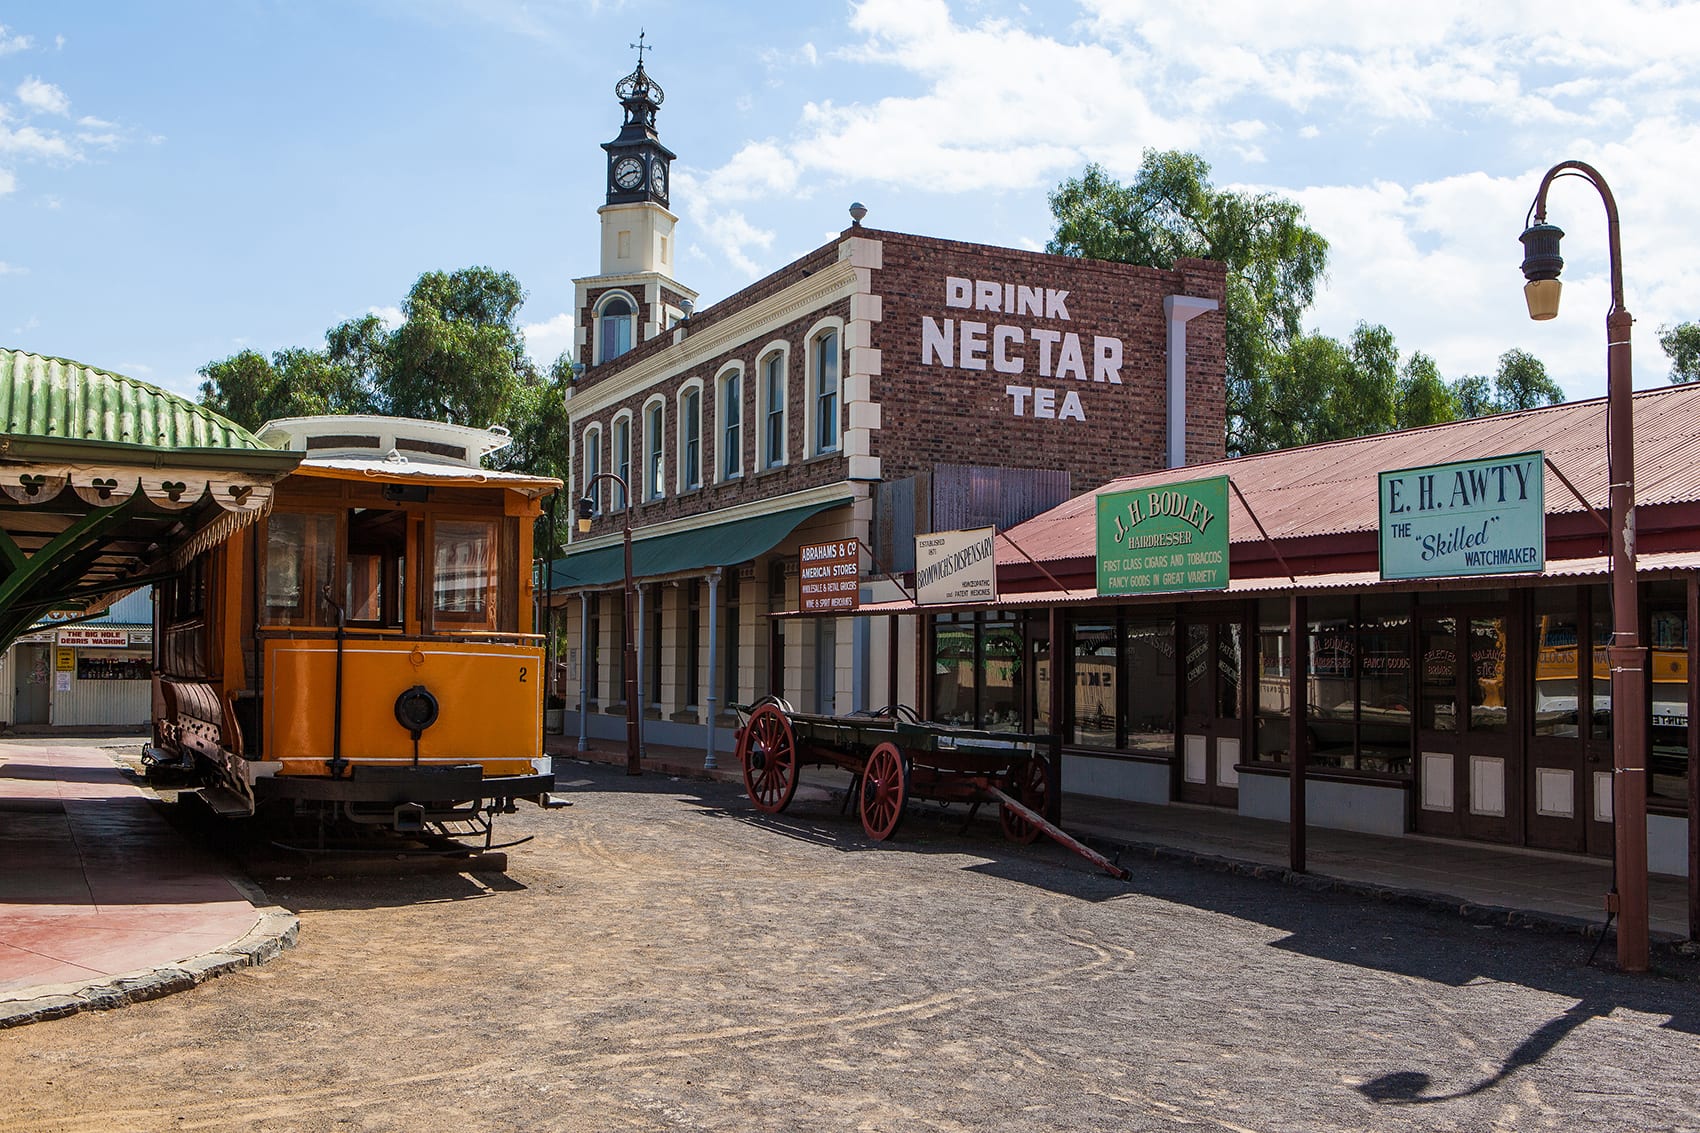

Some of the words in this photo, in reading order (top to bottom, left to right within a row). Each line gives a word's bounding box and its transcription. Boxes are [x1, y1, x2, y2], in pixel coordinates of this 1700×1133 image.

[946, 276, 1071, 321] DRINK
[922, 316, 1123, 384] NECTAR
[1006, 385, 1087, 422] TEA
[1389, 479, 1411, 514] E.
[1419, 475, 1443, 510] H.
[1449, 462, 1532, 508] AWTY
[1114, 515, 1129, 543] J.
[1128, 500, 1146, 527] H.
[1148, 491, 1214, 535] BODLEY
[1391, 523, 1412, 538] THE
[919, 538, 945, 548] ESTABLISHED
[1128, 531, 1192, 550] HAIRDRESSER
[802, 543, 837, 561] ABRAHAMS
[839, 543, 845, 558] &
[953, 535, 994, 573] DISPENSARY
[1103, 559, 1121, 572] FIRST
[1123, 557, 1143, 571] CLASS
[1144, 555, 1168, 569] CIGARS
[1170, 554, 1184, 567] AND
[1187, 550, 1223, 565] TOBACCOS
[1465, 547, 1537, 567] WATCHMAKER
[802, 566, 831, 579] AMERICAN
[833, 563, 857, 577] STORES
[1108, 576, 1129, 588] FANCY
[1130, 574, 1151, 587] GOODS
[1153, 573, 1160, 586] IN
[1163, 572, 1185, 585] GREAT
[1187, 569, 1217, 583] VARIETY
[823, 583, 827, 592] &
[827, 582, 840, 592] RETAIL
[954, 589, 969, 597] PATENT
[970, 588, 991, 597] MEDICINES
[815, 599, 819, 608] &
[1363, 657, 1384, 668] FANCY
[1387, 657, 1410, 669] GOODS
[1538, 651, 1575, 664] CLOCKS
[519, 666, 527, 682] 2
